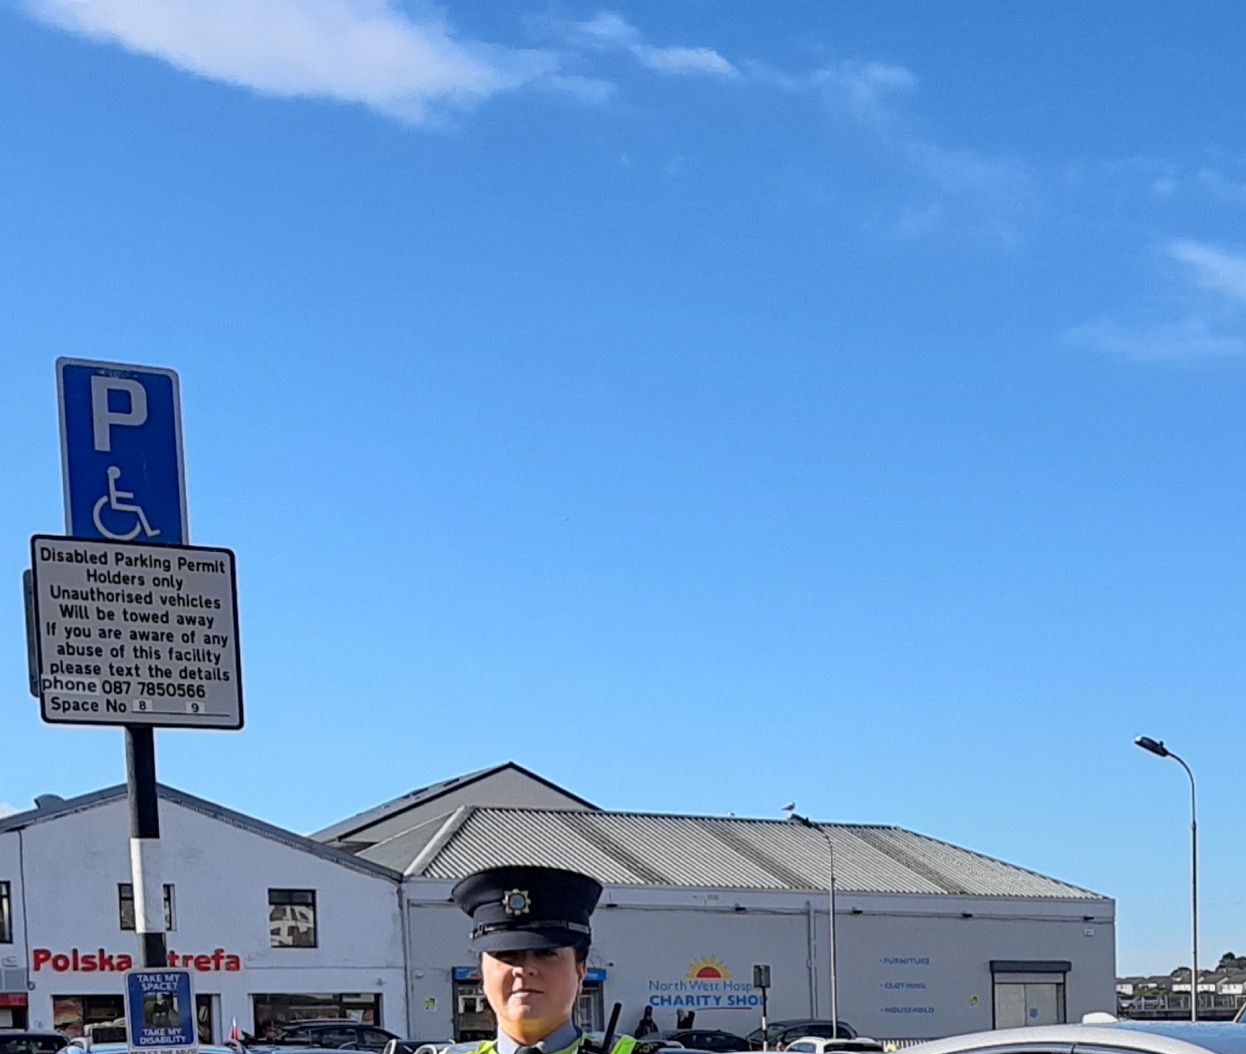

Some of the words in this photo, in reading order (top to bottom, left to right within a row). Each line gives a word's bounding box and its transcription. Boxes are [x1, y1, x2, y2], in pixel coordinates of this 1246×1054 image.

[90, 375, 147, 452] P
[40, 547, 108, 565] Disabled
[114, 552, 171, 572] Parking
[178, 557, 226, 574] Permit
[86, 568, 145, 586] Holders
[152, 574, 183, 591] only
[50, 584, 153, 605] Unauthorised
[160, 593, 221, 609] vehicles
[59, 604, 90, 619] Will
[96, 606, 115, 621] be
[122, 608, 169, 624] towed
[176, 614, 214, 629] away
[46, 621, 56, 636] If
[64, 626, 91, 640] you
[98, 628, 122, 639] are
[129, 629, 174, 642] aware
[181, 630, 195, 643] of
[204, 634, 228, 648] any
[57, 641, 103, 657] abuse
[110, 644, 125, 658] of
[133, 645, 161, 660] this
[168, 647, 221, 666] facility
[50, 660, 101, 675] please
[108, 662, 141, 677] text
[148, 664, 172, 679] the
[179, 665, 230, 682] details
[42, 676, 97, 692] phone
[102, 680, 131, 695] 087
[137, 681, 206, 698] 7850566
[51, 696, 99, 713] Space
[106, 698, 127, 713] No
[139, 700, 147, 711] 8
[191, 703, 199, 713] 9
[32, 948, 133, 972] Polska
[166, 948, 241, 972] trefa
[137, 974, 161, 983] TAKE
[164, 973, 180, 982] MY
[141, 982, 178, 991] SPACE?
[649, 980, 687, 991] North
[689, 980, 720, 991] West
[723, 980, 753, 993] Hosp
[649, 995, 722, 1006] CHARITY
[140, 1035, 187, 1045] DISABILITY
[143, 1028, 165, 1036] TAKE
[168, 1027, 182, 1035] MY
